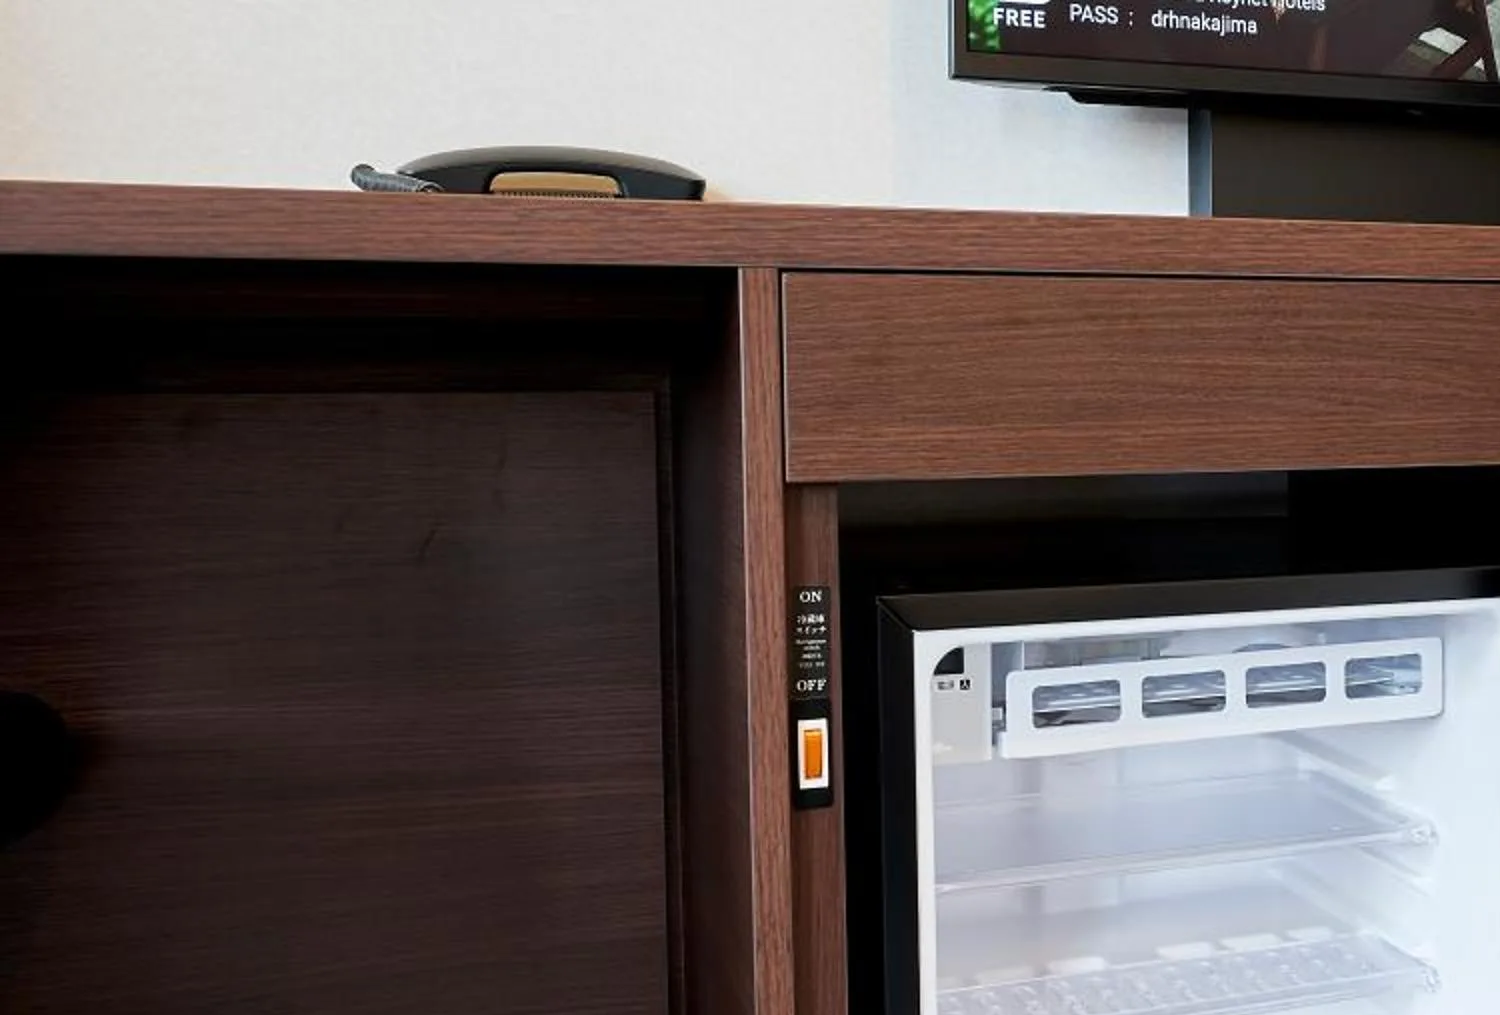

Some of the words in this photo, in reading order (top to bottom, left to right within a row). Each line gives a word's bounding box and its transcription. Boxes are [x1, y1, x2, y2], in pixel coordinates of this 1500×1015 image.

[993, 7, 1046, 28] FREE
[1069, 3, 1119, 25] PASS
[1151, 9, 1258, 37] drhnakajima
[800, 589, 822, 603] ON
[797, 679, 827, 692] OFF
